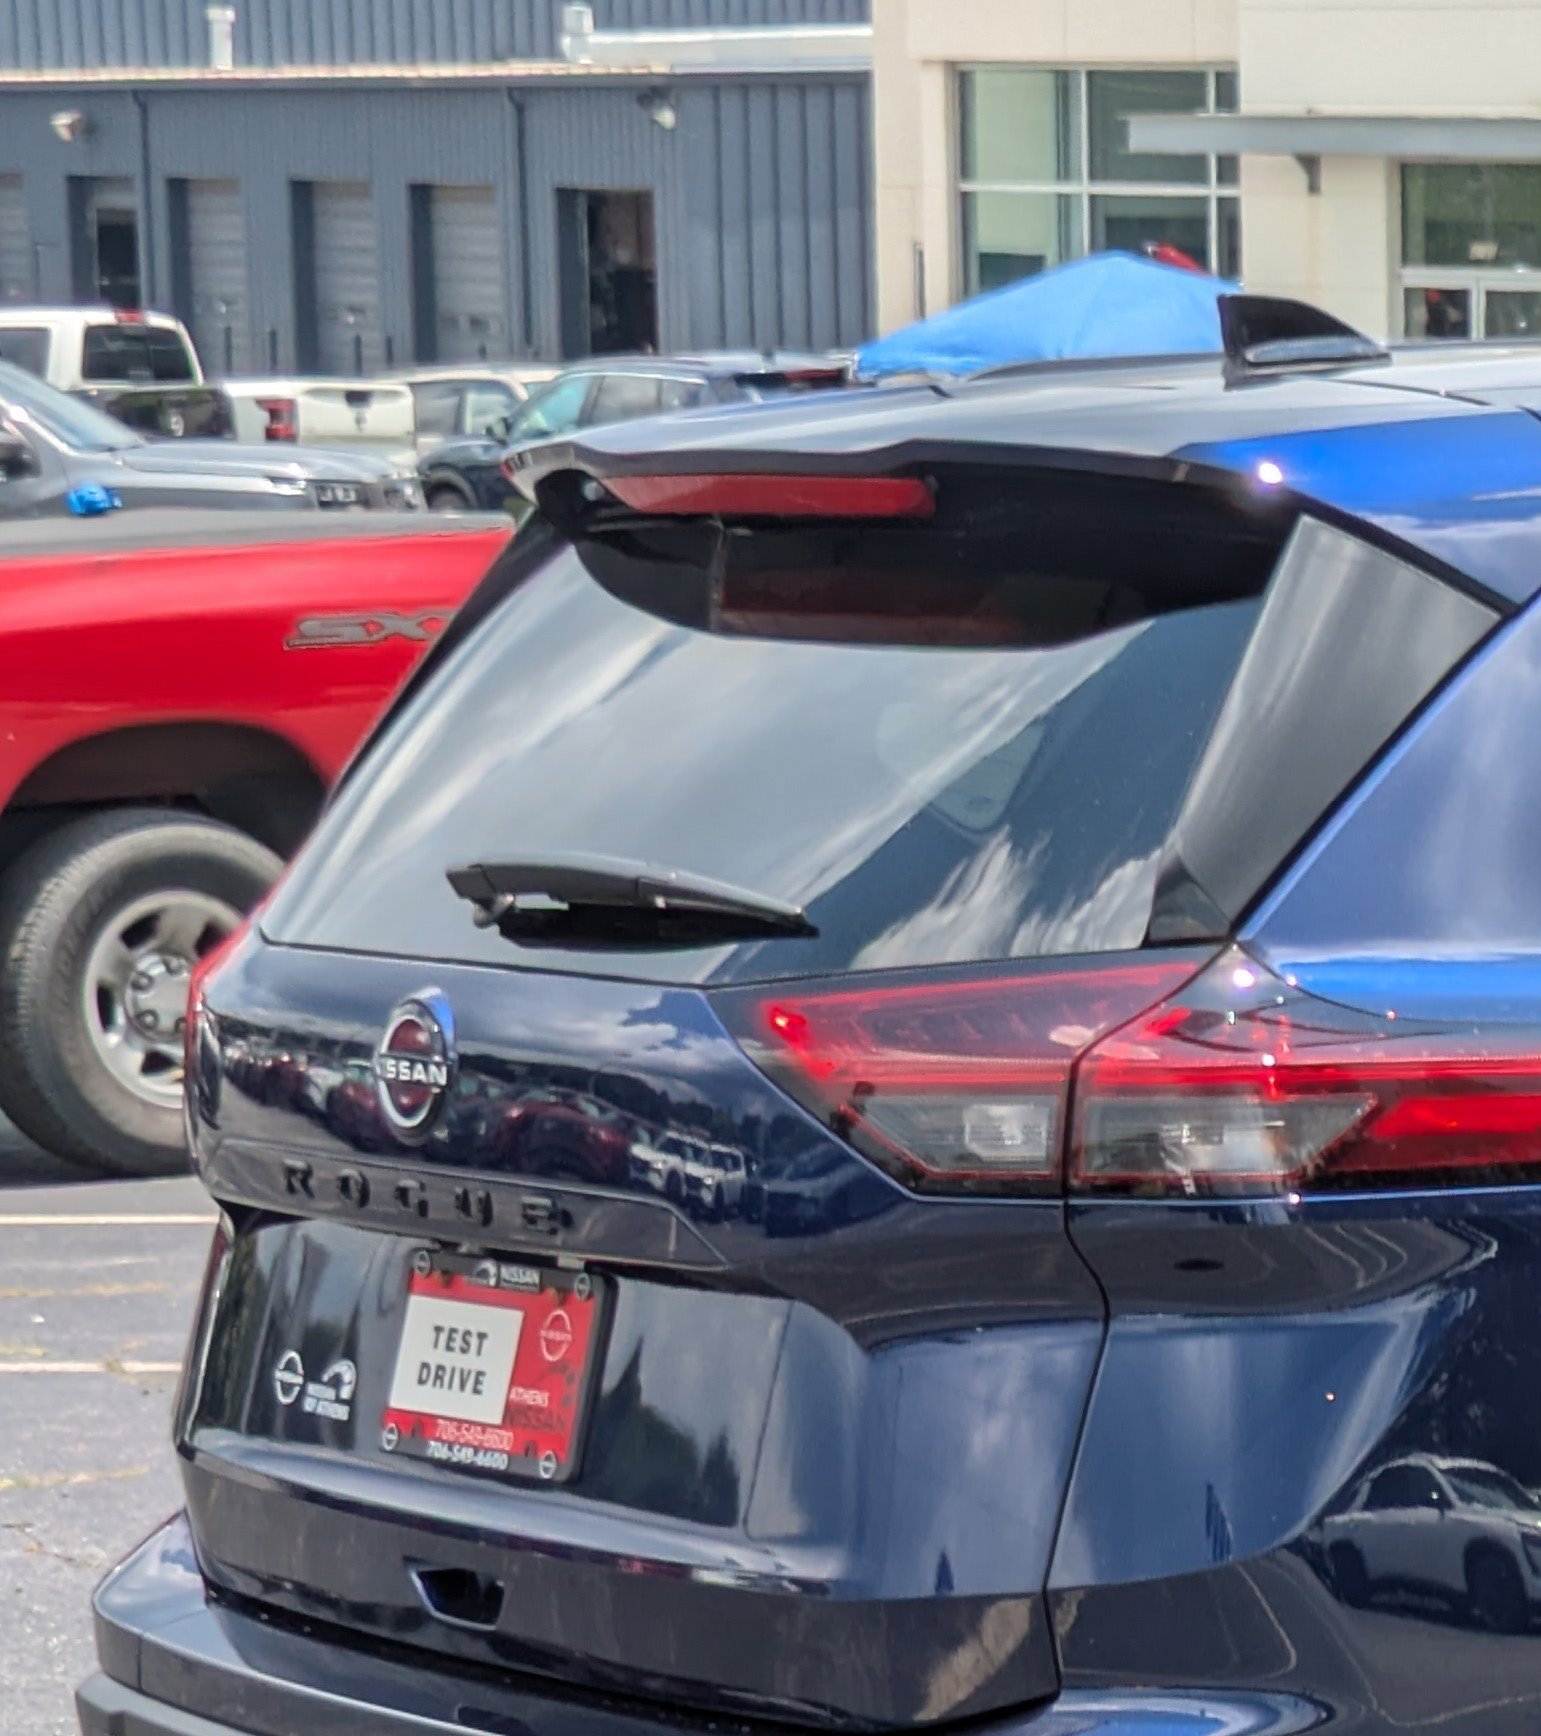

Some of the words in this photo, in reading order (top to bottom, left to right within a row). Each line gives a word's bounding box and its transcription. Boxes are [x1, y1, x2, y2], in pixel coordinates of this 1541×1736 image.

[288, 606, 460, 649] SX
[376, 1056, 448, 1086] SSAN
[282, 1157, 574, 1237] ROGUE
[432, 1324, 489, 1357] TEST
[416, 1361, 488, 1396] DRIVE
